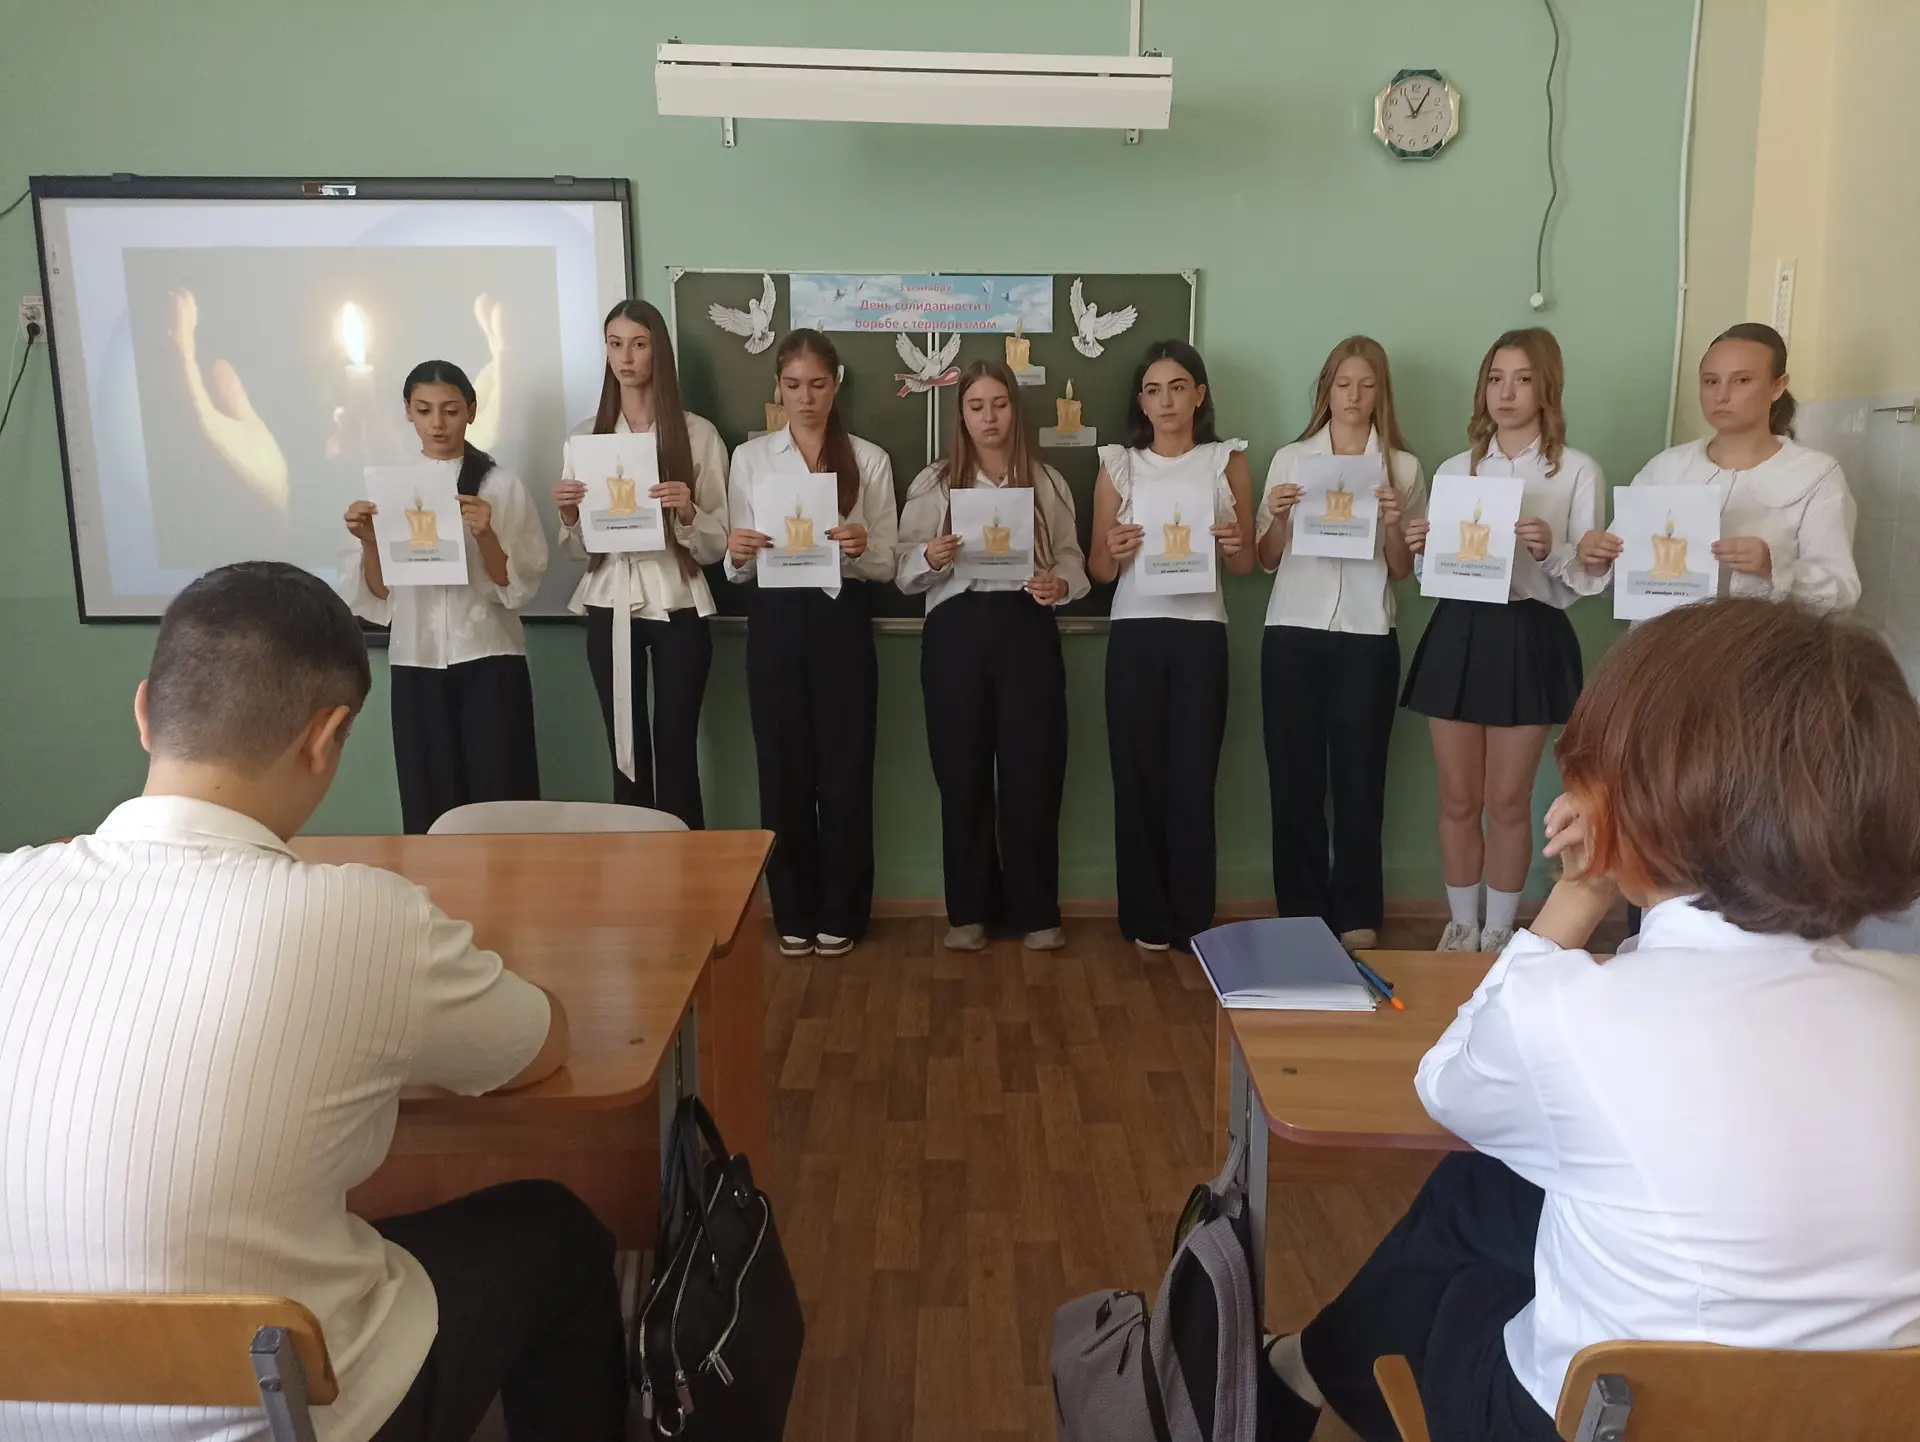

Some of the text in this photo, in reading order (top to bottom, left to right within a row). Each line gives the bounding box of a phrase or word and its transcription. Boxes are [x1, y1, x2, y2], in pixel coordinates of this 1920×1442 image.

[1412, 83, 1421, 93] 12
[1389, 97, 1398, 107] 10
[1387, 124, 1394, 134] 8
[1431, 124, 1439, 134] 4
[859, 299, 890, 311] День
[895, 302, 980, 312] солидарности
[855, 317, 899, 330] борьбе
[902, 320, 908, 329] с
